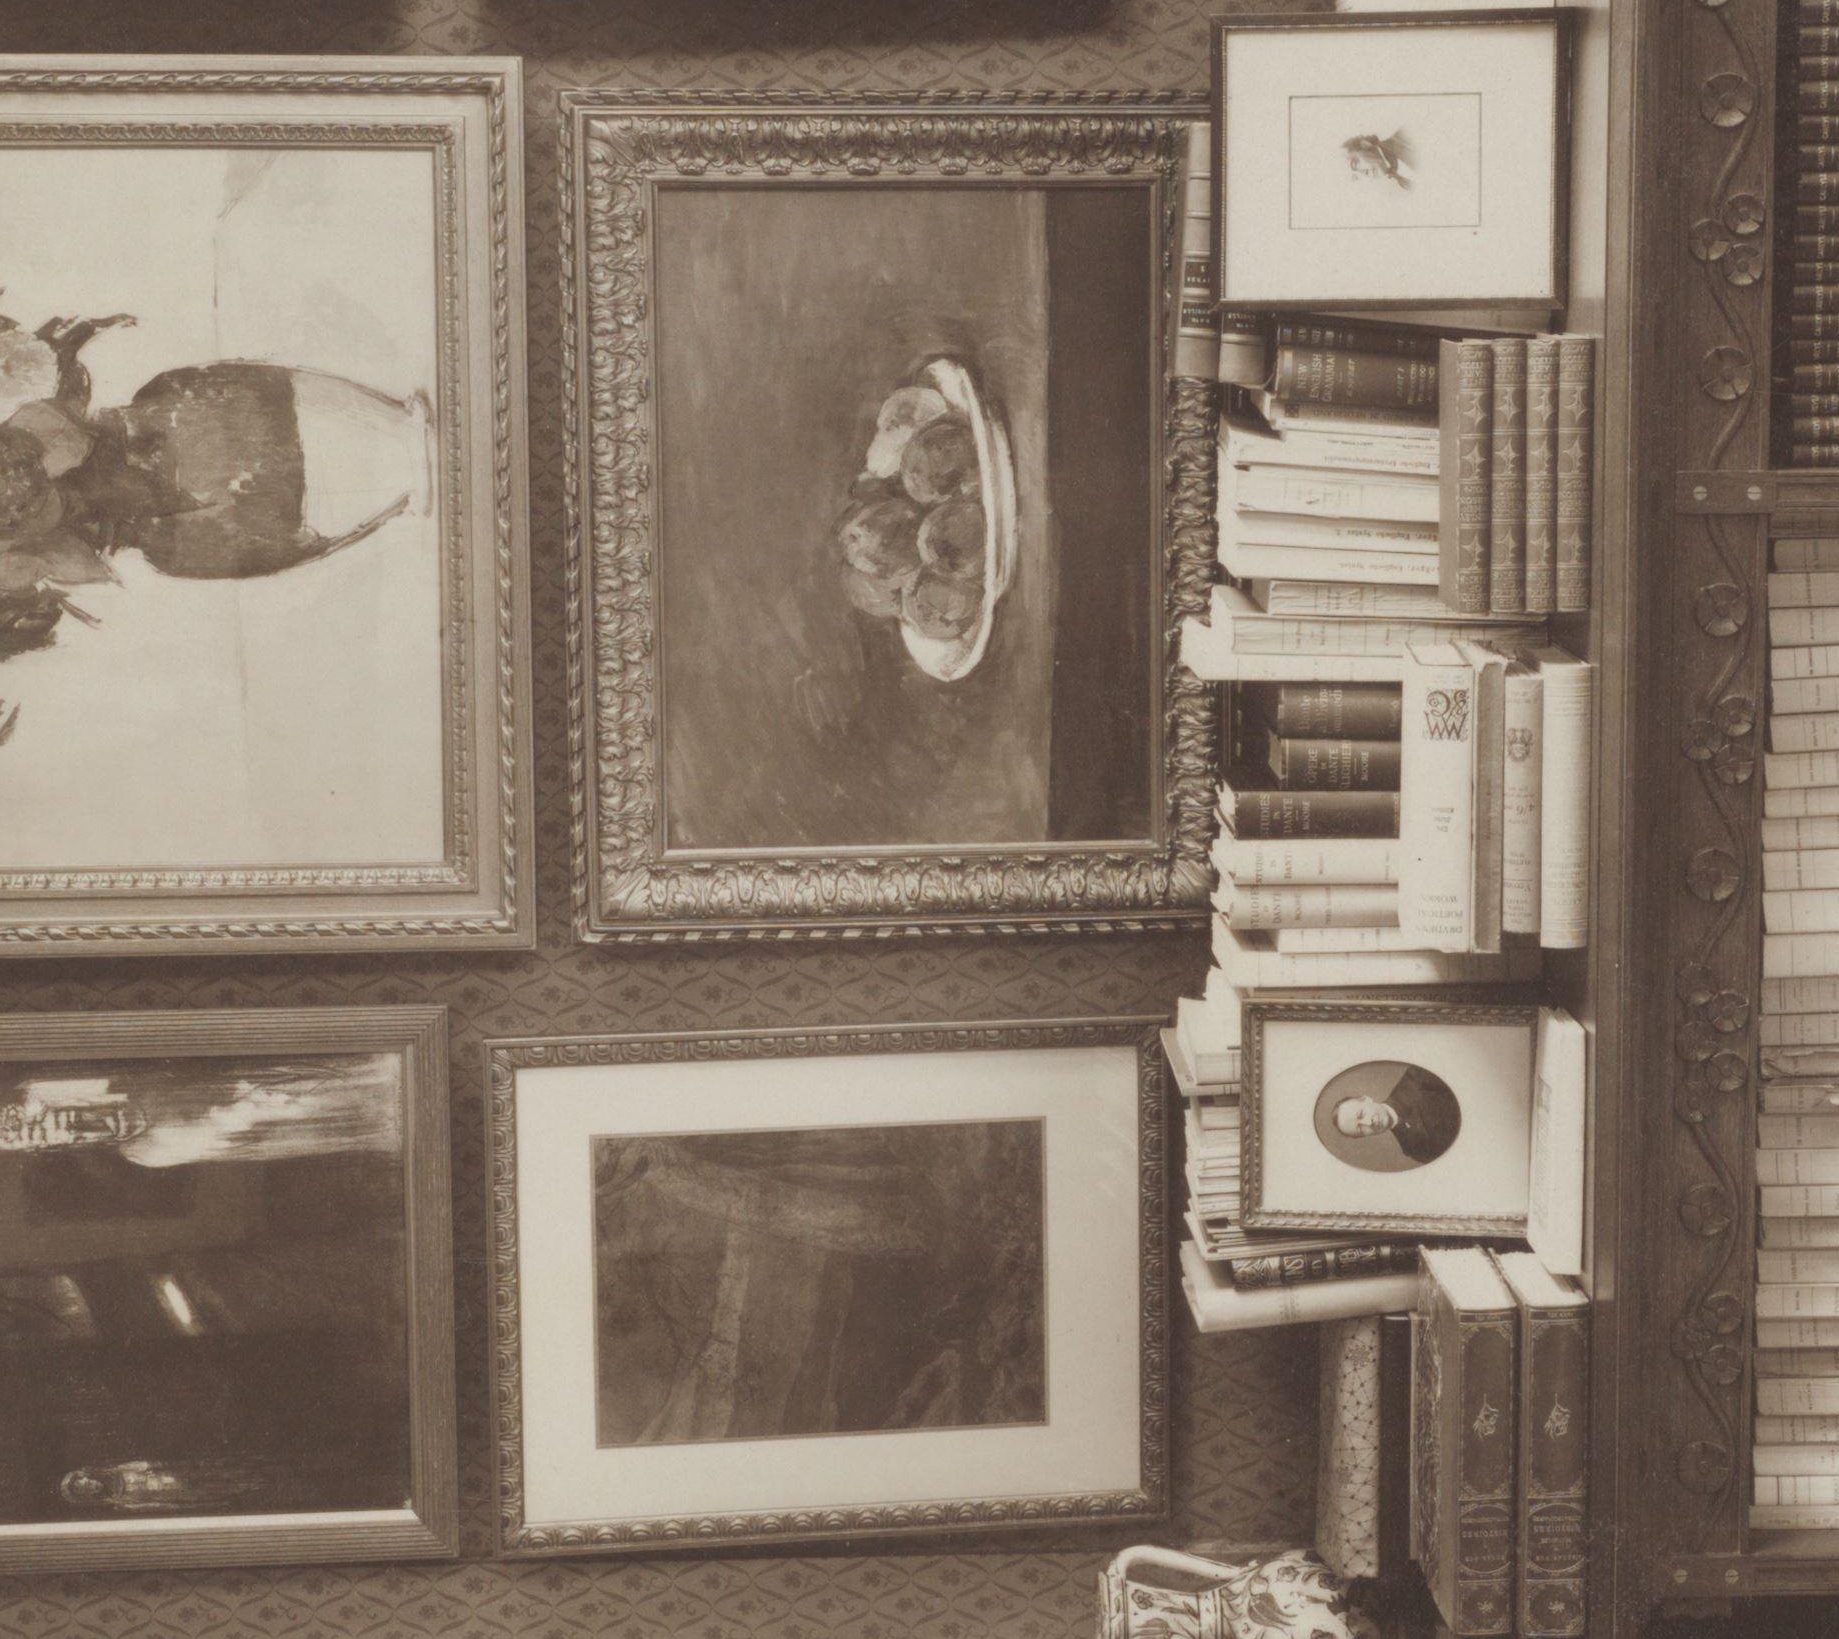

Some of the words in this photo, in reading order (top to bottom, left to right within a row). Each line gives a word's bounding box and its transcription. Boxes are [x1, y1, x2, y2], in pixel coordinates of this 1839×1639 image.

[1821, 27, 1829, 52] CARLYL
[1821, 116, 1829, 139] CARLYL
[1817, 146, 1825, 168] CARLYL
[1817, 236, 1825, 259] CARLYL
[1814, 314, 1822, 336] CARLYL
[1297, 362, 1307, 390] NEW
[1309, 353, 1322, 398] ENGLISH
[1323, 350, 1335, 402] GRAMMAR
[1315, 688, 1329, 723] Divin
[1330, 689, 1343, 732] ommedi
[1307, 747, 1318, 783] OPERE
[1328, 747, 1338, 783] DANTE
[1361, 751, 1369, 782] MOORE
[1259, 793, 1271, 837] STUDIES
[1273, 810, 1281, 820] IN
[1283, 797, 1293, 834] DANTE
[1302, 799, 1311, 830] MOORE
[1249, 884, 1259, 929] STUDIES
[1272, 890, 1281, 926] DANTE
